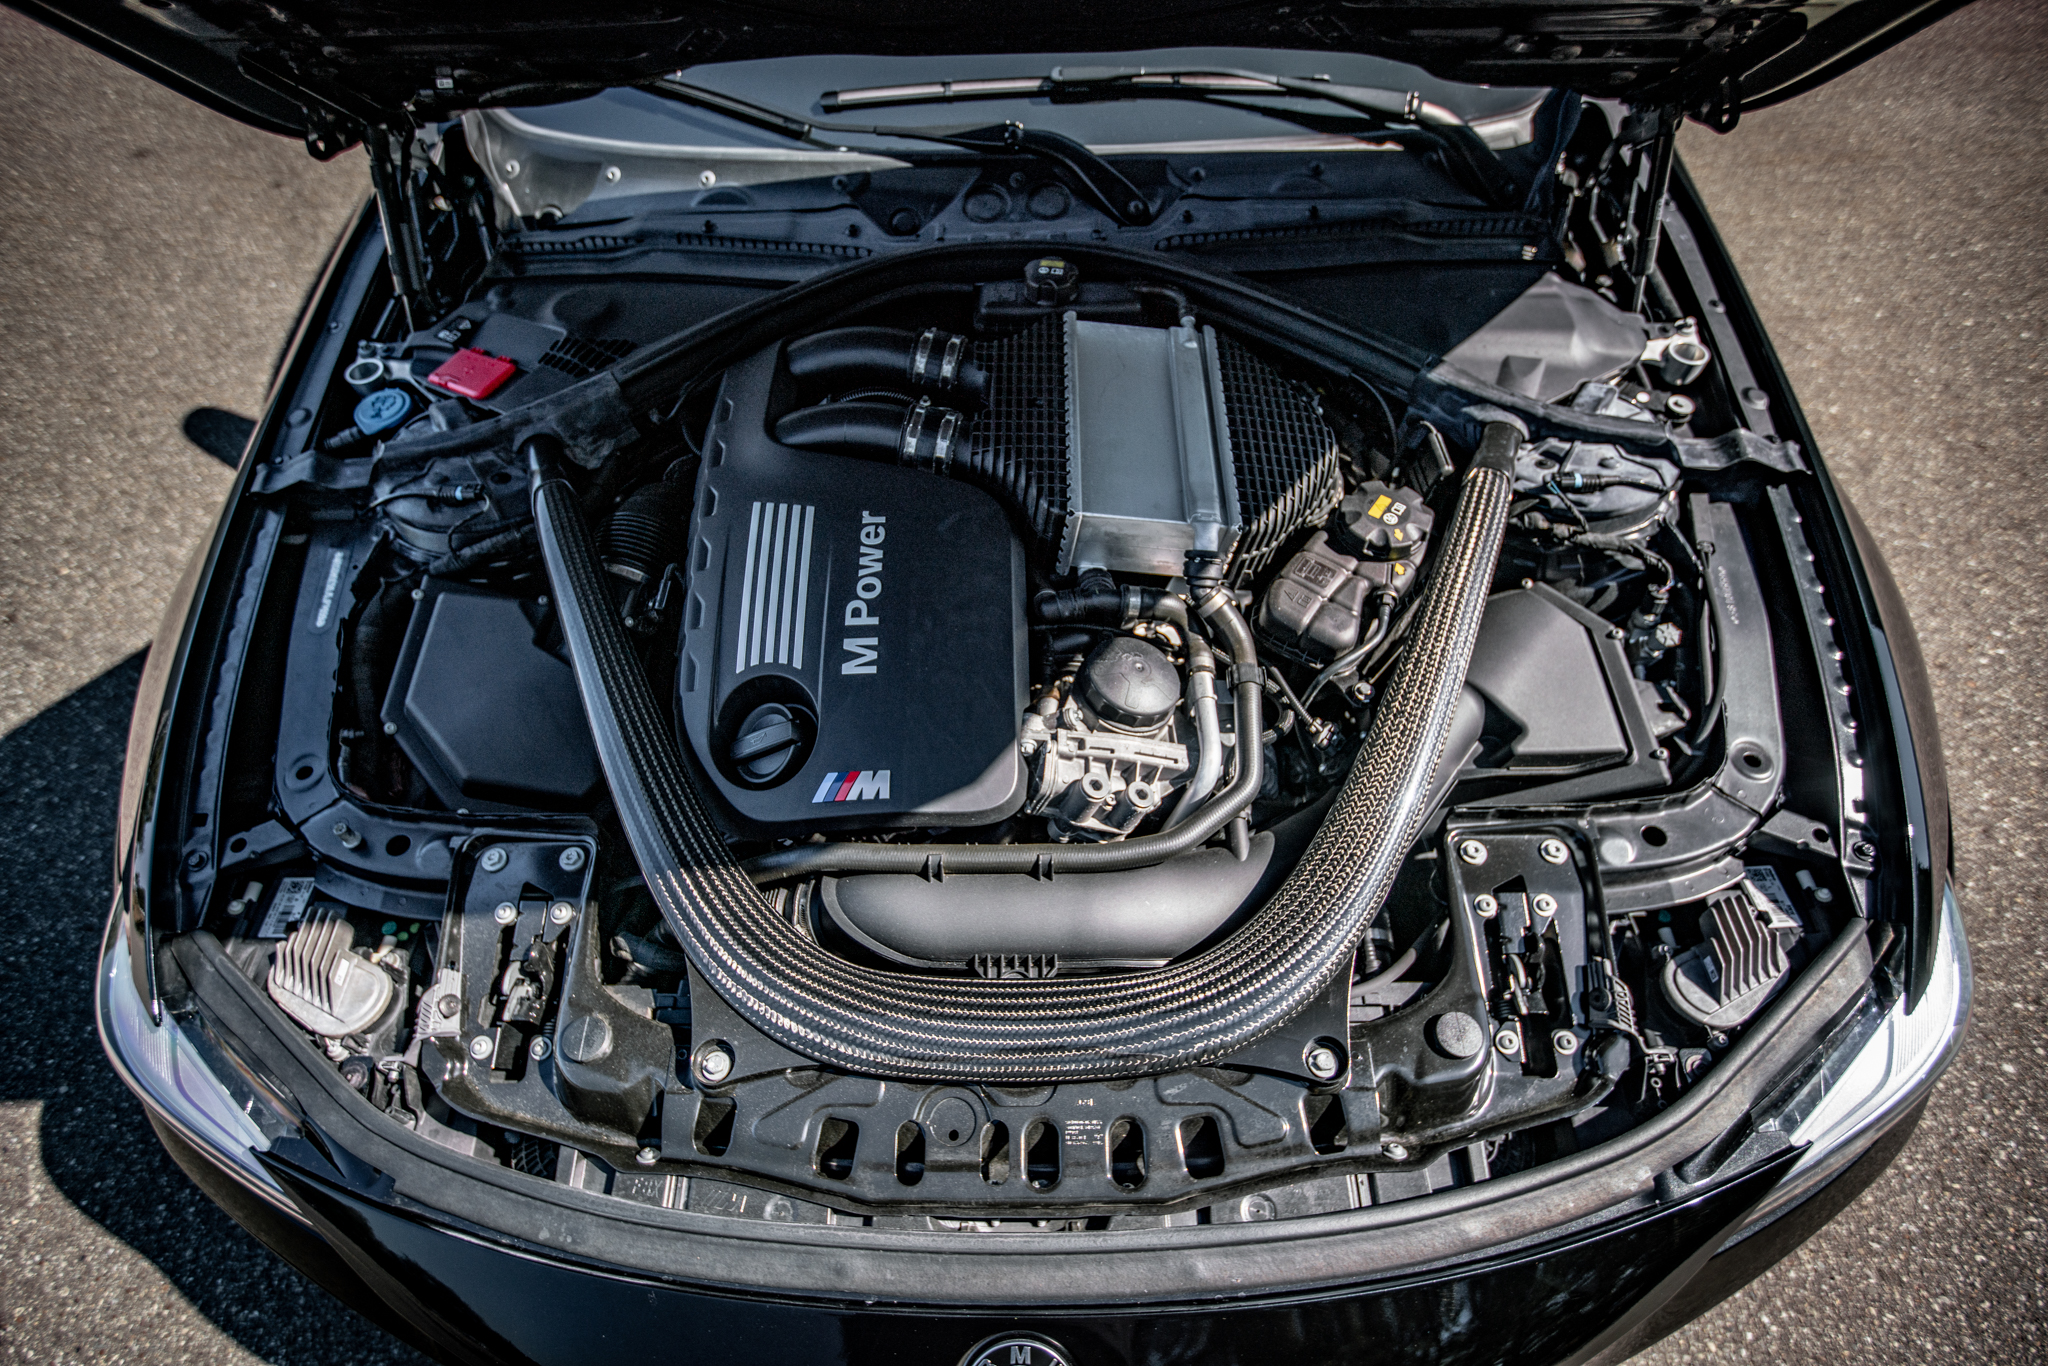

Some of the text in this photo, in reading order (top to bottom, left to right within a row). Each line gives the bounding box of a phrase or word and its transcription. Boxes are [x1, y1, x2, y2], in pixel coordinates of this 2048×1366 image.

[841, 510, 887, 675] M Power
[845, 769, 891, 802] M
